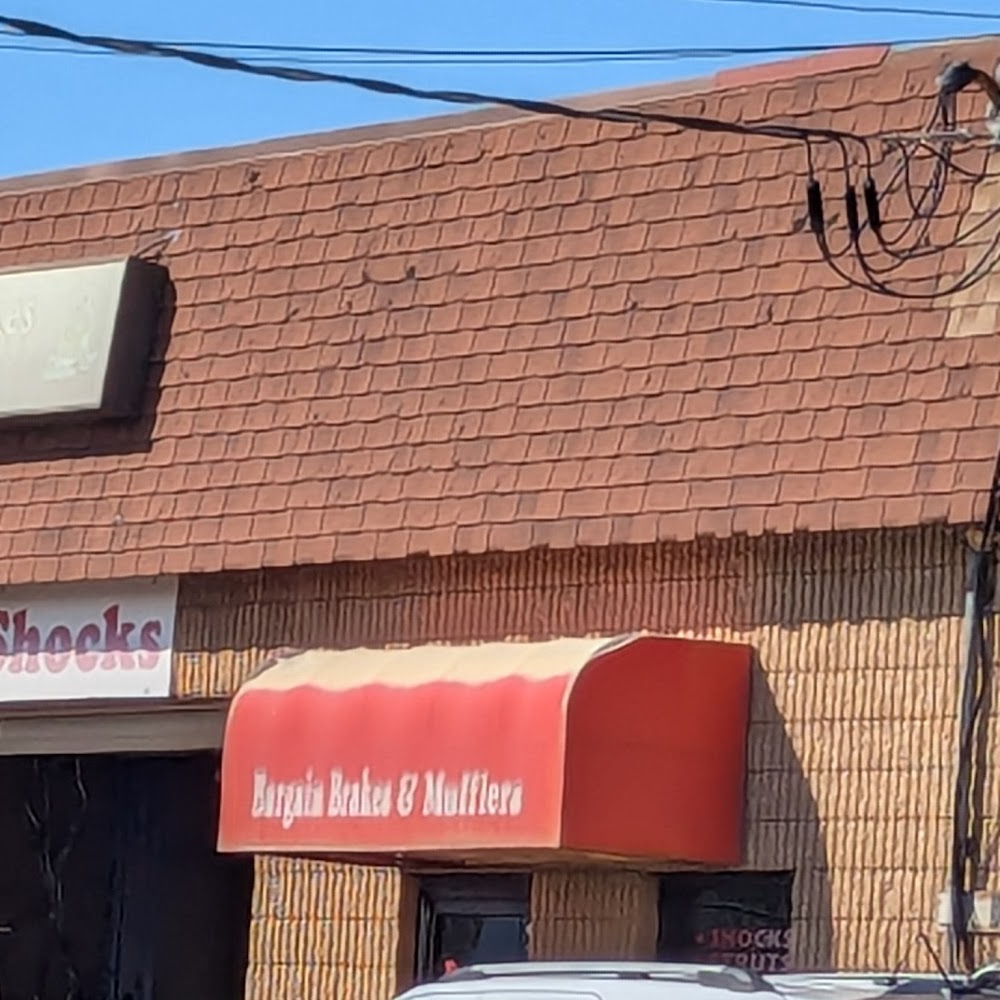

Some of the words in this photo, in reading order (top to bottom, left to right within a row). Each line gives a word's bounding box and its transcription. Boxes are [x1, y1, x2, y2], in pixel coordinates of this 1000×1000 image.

[252, 768, 324, 829] Bargain
[327, 766, 393, 817] Brakes
[397, 771, 418, 816] &
[422, 768, 523, 816] Mufflers
